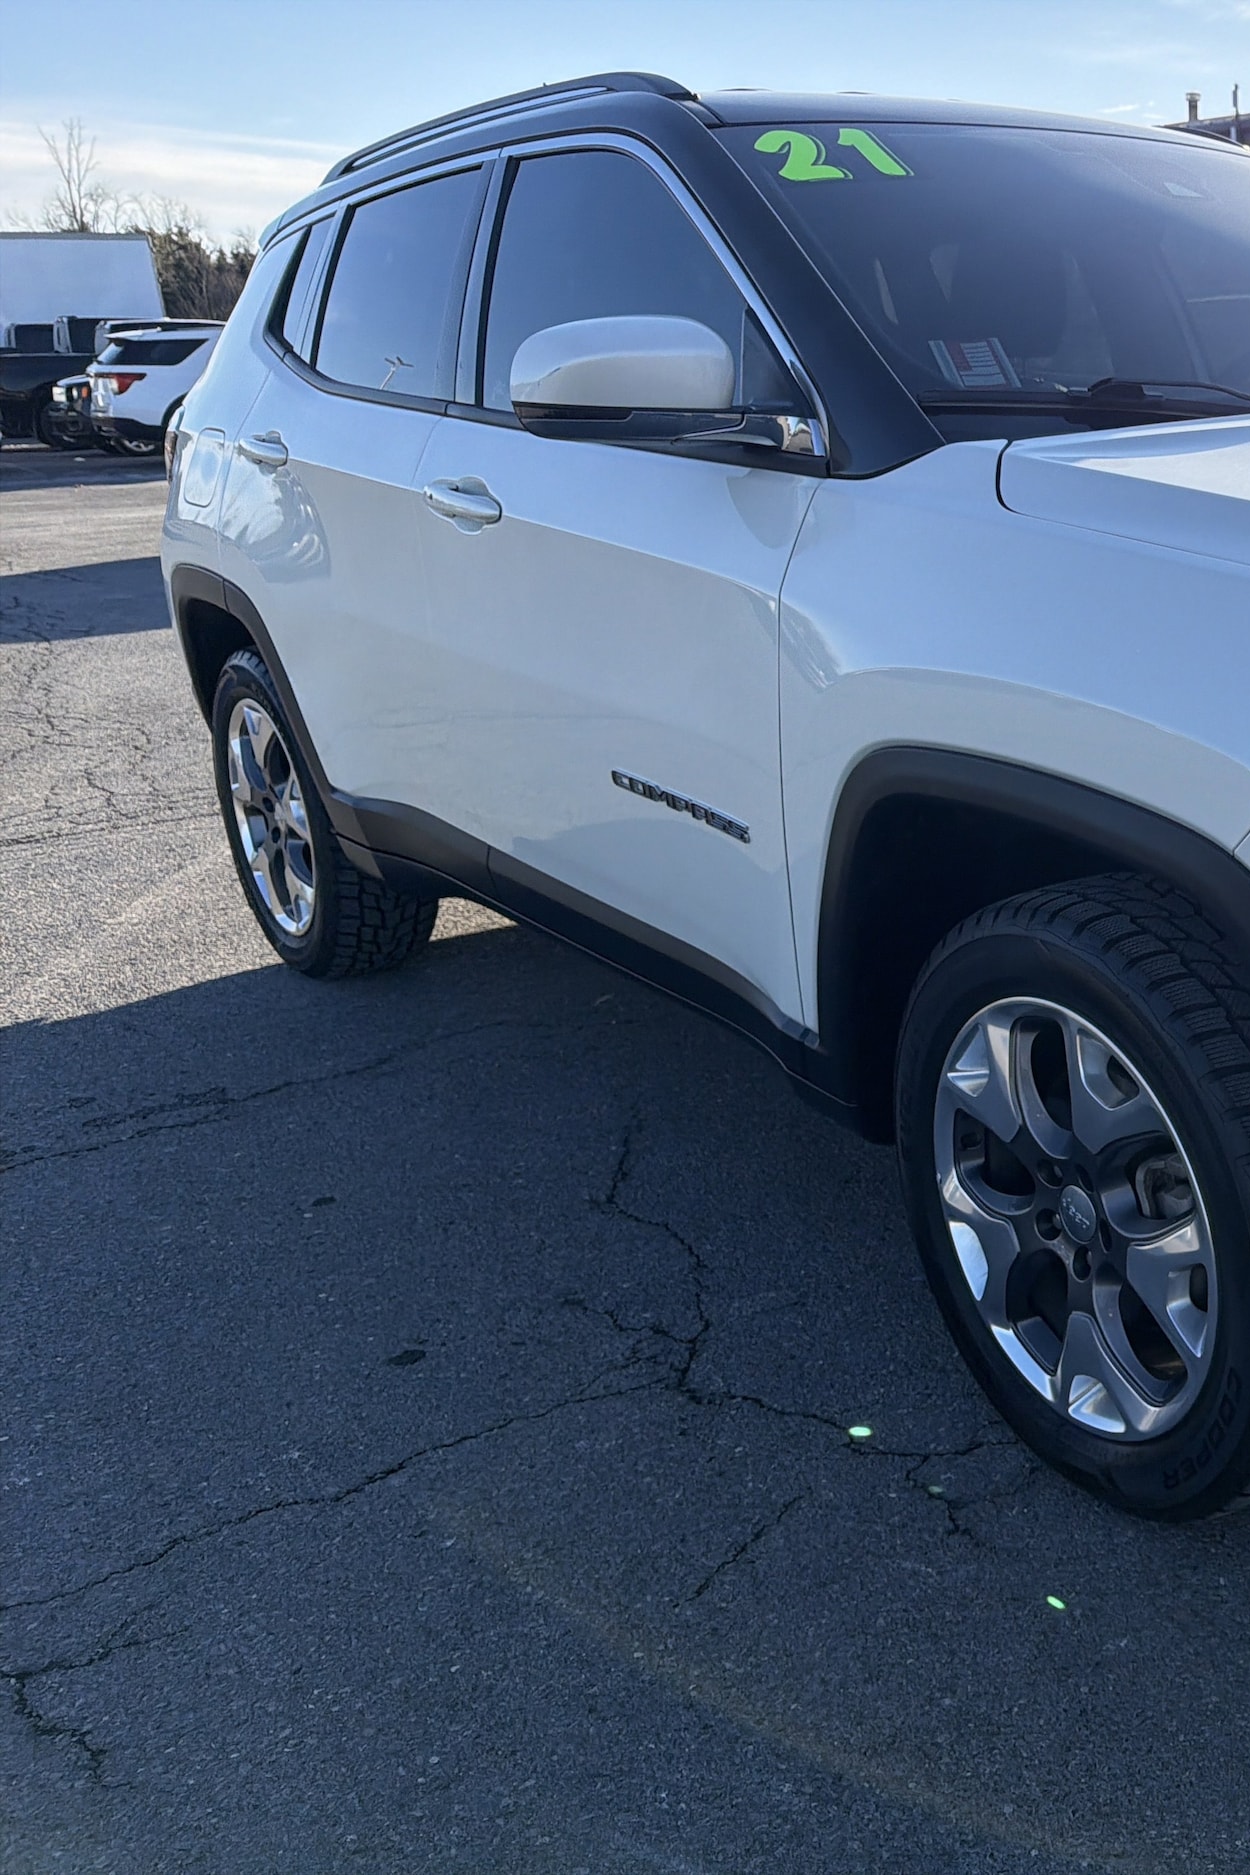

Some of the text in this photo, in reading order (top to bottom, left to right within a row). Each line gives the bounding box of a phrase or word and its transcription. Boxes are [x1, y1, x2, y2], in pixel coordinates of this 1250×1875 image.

[754, 128, 914, 181] 21
[611, 767, 751, 844] COMPASS
[1162, 1366, 1242, 1489] COOPER
